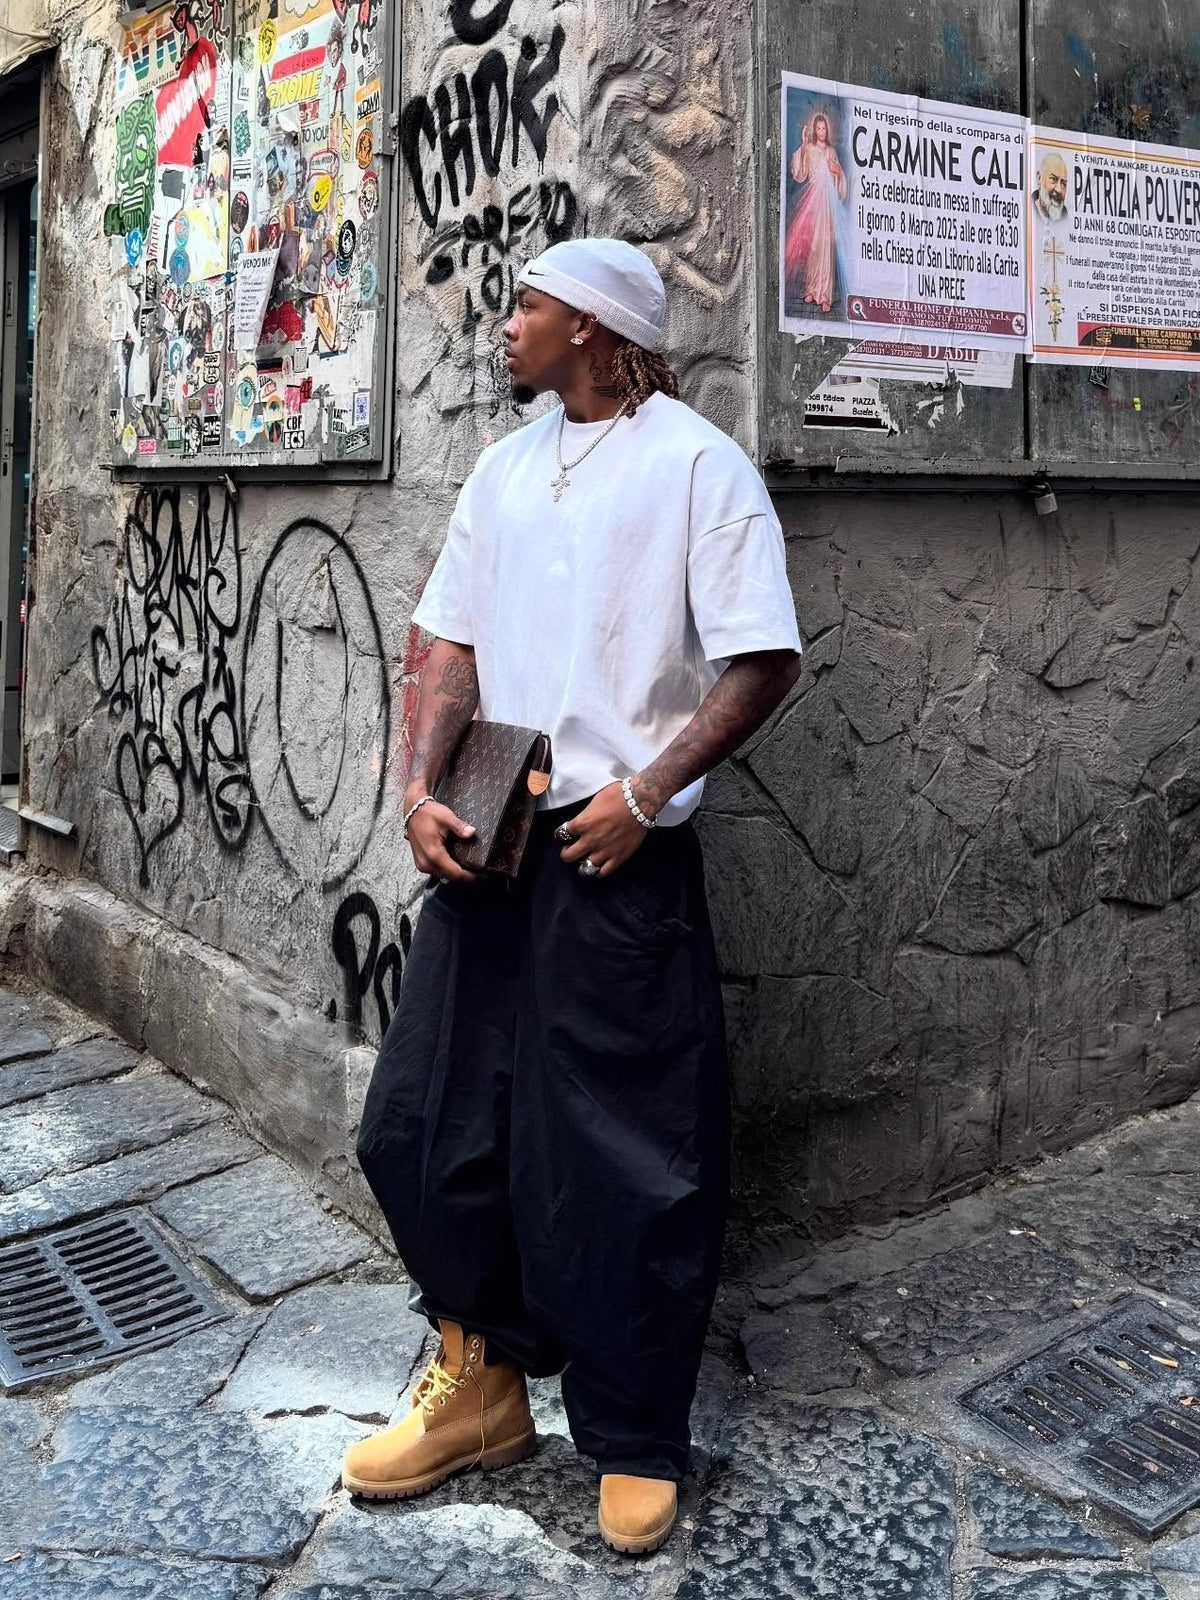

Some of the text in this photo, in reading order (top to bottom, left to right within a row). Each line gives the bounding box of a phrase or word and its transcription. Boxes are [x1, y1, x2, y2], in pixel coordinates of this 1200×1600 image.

[302, 128, 311, 143] TO
[854, 106, 1024, 145] Nel trigesimo della scomparsa di
[852, 125, 962, 182] CARMINE
[1080, 155, 1109, 167] VENUTA
[1110, 160, 1116, 168] A
[1117, 160, 1149, 172] MANCARE
[1150, 164, 1160, 174] LA
[1161, 166, 1180, 176] CARA
[860, 174, 880, 200] Sarà
[944, 192, 970, 213] messa
[972, 192, 980, 213] in
[982, 194, 1020, 222] suffragio
[1074, 165, 1200, 226] PATRIZIA POLVER
[858, 205, 1019, 248] il giorno 8 Marzo 2025 alle ore 18:30
[1074, 216, 1200, 243] DI ANNI 68 CONIUGATA ESPOSITO
[1069, 233, 1077, 243] Ne
[1078, 234, 1094, 244] danno
[1099, 236, 1114, 247] triste
[861, 237, 883, 262] nella
[886, 239, 914, 265] Chiesa
[916, 242, 924, 266] di
[927, 244, 942, 269] San
[945, 246, 974, 273] Liborio
[976, 251, 991, 274] alla
[1109, 249, 1114, 258] le
[1069, 256, 1090, 267] funerali
[1092, 258, 1124, 271] muoveranno
[1148, 263, 1154, 273] 14
[1156, 264, 1178, 276] febbraio
[1092, 270, 1106, 281] dalla
[1106, 273, 1118, 283] casa
[918, 274, 966, 301] UNA PRECE
[1074, 279, 1085, 289] rito
[1086, 280, 1110, 291] funebre
[1166, 288, 1176, 297] ore
[1177, 289, 1195, 298] 12:00
[869, 298, 912, 312] FUNERAL
[914, 303, 942, 315] HOME
[943, 305, 989, 319] CAMPANIA
[1114, 293, 1120, 302] di
[1122, 294, 1132, 303] San
[1134, 295, 1155, 305] Liborio
[1156, 297, 1167, 306] Alla
[1078, 312, 1084, 321] IL
[1086, 313, 1126, 324] PRESENTE
[1127, 316, 1146, 326] VALE
[1148, 318, 1163, 327] PER
[1100, 303, 1200, 320] SI DISPENSA DAI FIO
[1110, 326, 1140, 337] FUNERAL
[1140, 329, 1160, 337] HOME
[1160, 330, 1192, 340] CAMPANIA
[852, 396, 876, 406] PIAZZA
